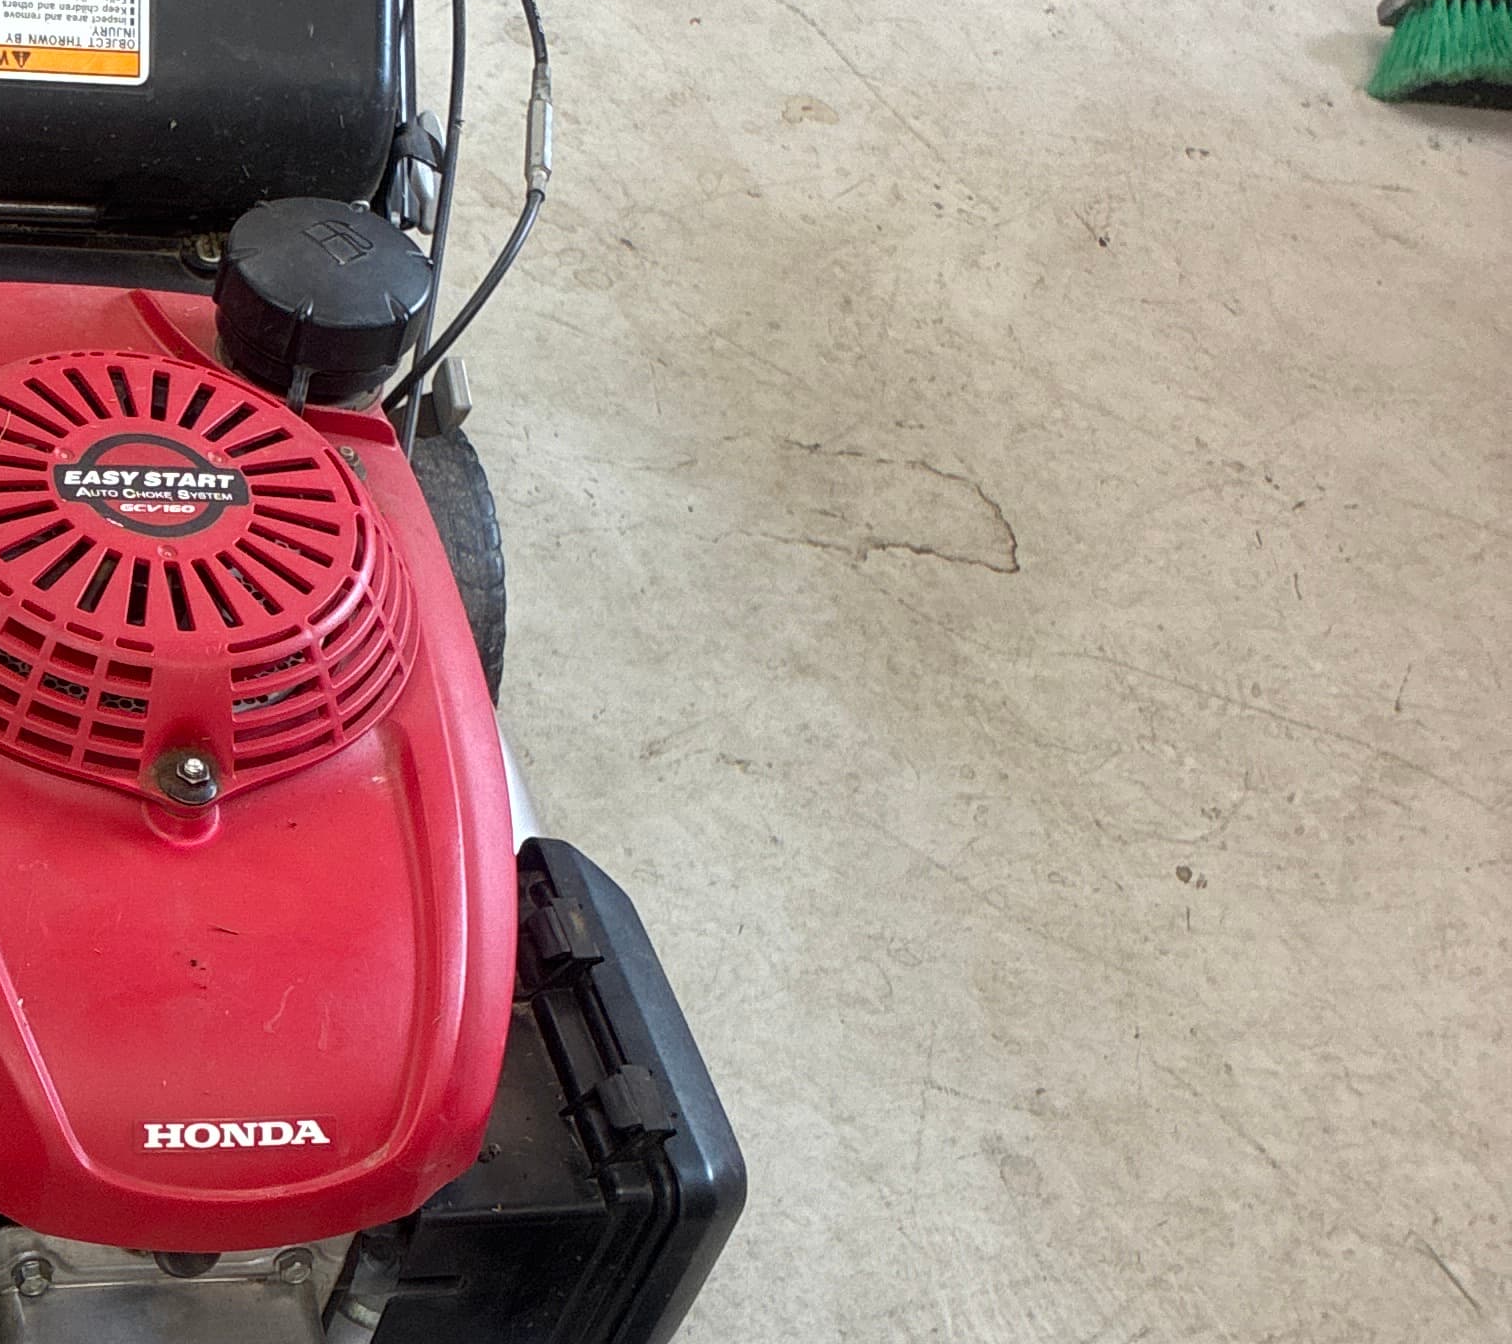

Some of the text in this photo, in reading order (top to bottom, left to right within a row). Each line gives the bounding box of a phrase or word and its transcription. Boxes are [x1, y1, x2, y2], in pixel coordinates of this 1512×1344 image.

[3, 1, 34, 10] others
[39, 3, 56, 12] and
[60, 4, 99, 14] children
[103, 5, 127, 15] Keep
[5, 11, 41, 20] remove
[46, 13, 62, 23] and
[92, 15, 126, 26] Inspect
[6, 33, 22, 44] BY
[29, 34, 82, 47] THROWN
[89, 38, 135, 50] OBJECT
[64, 470, 234, 489] EASY START
[120, 503, 195, 514] GCV160
[144, 1119, 330, 1149] HONDA
